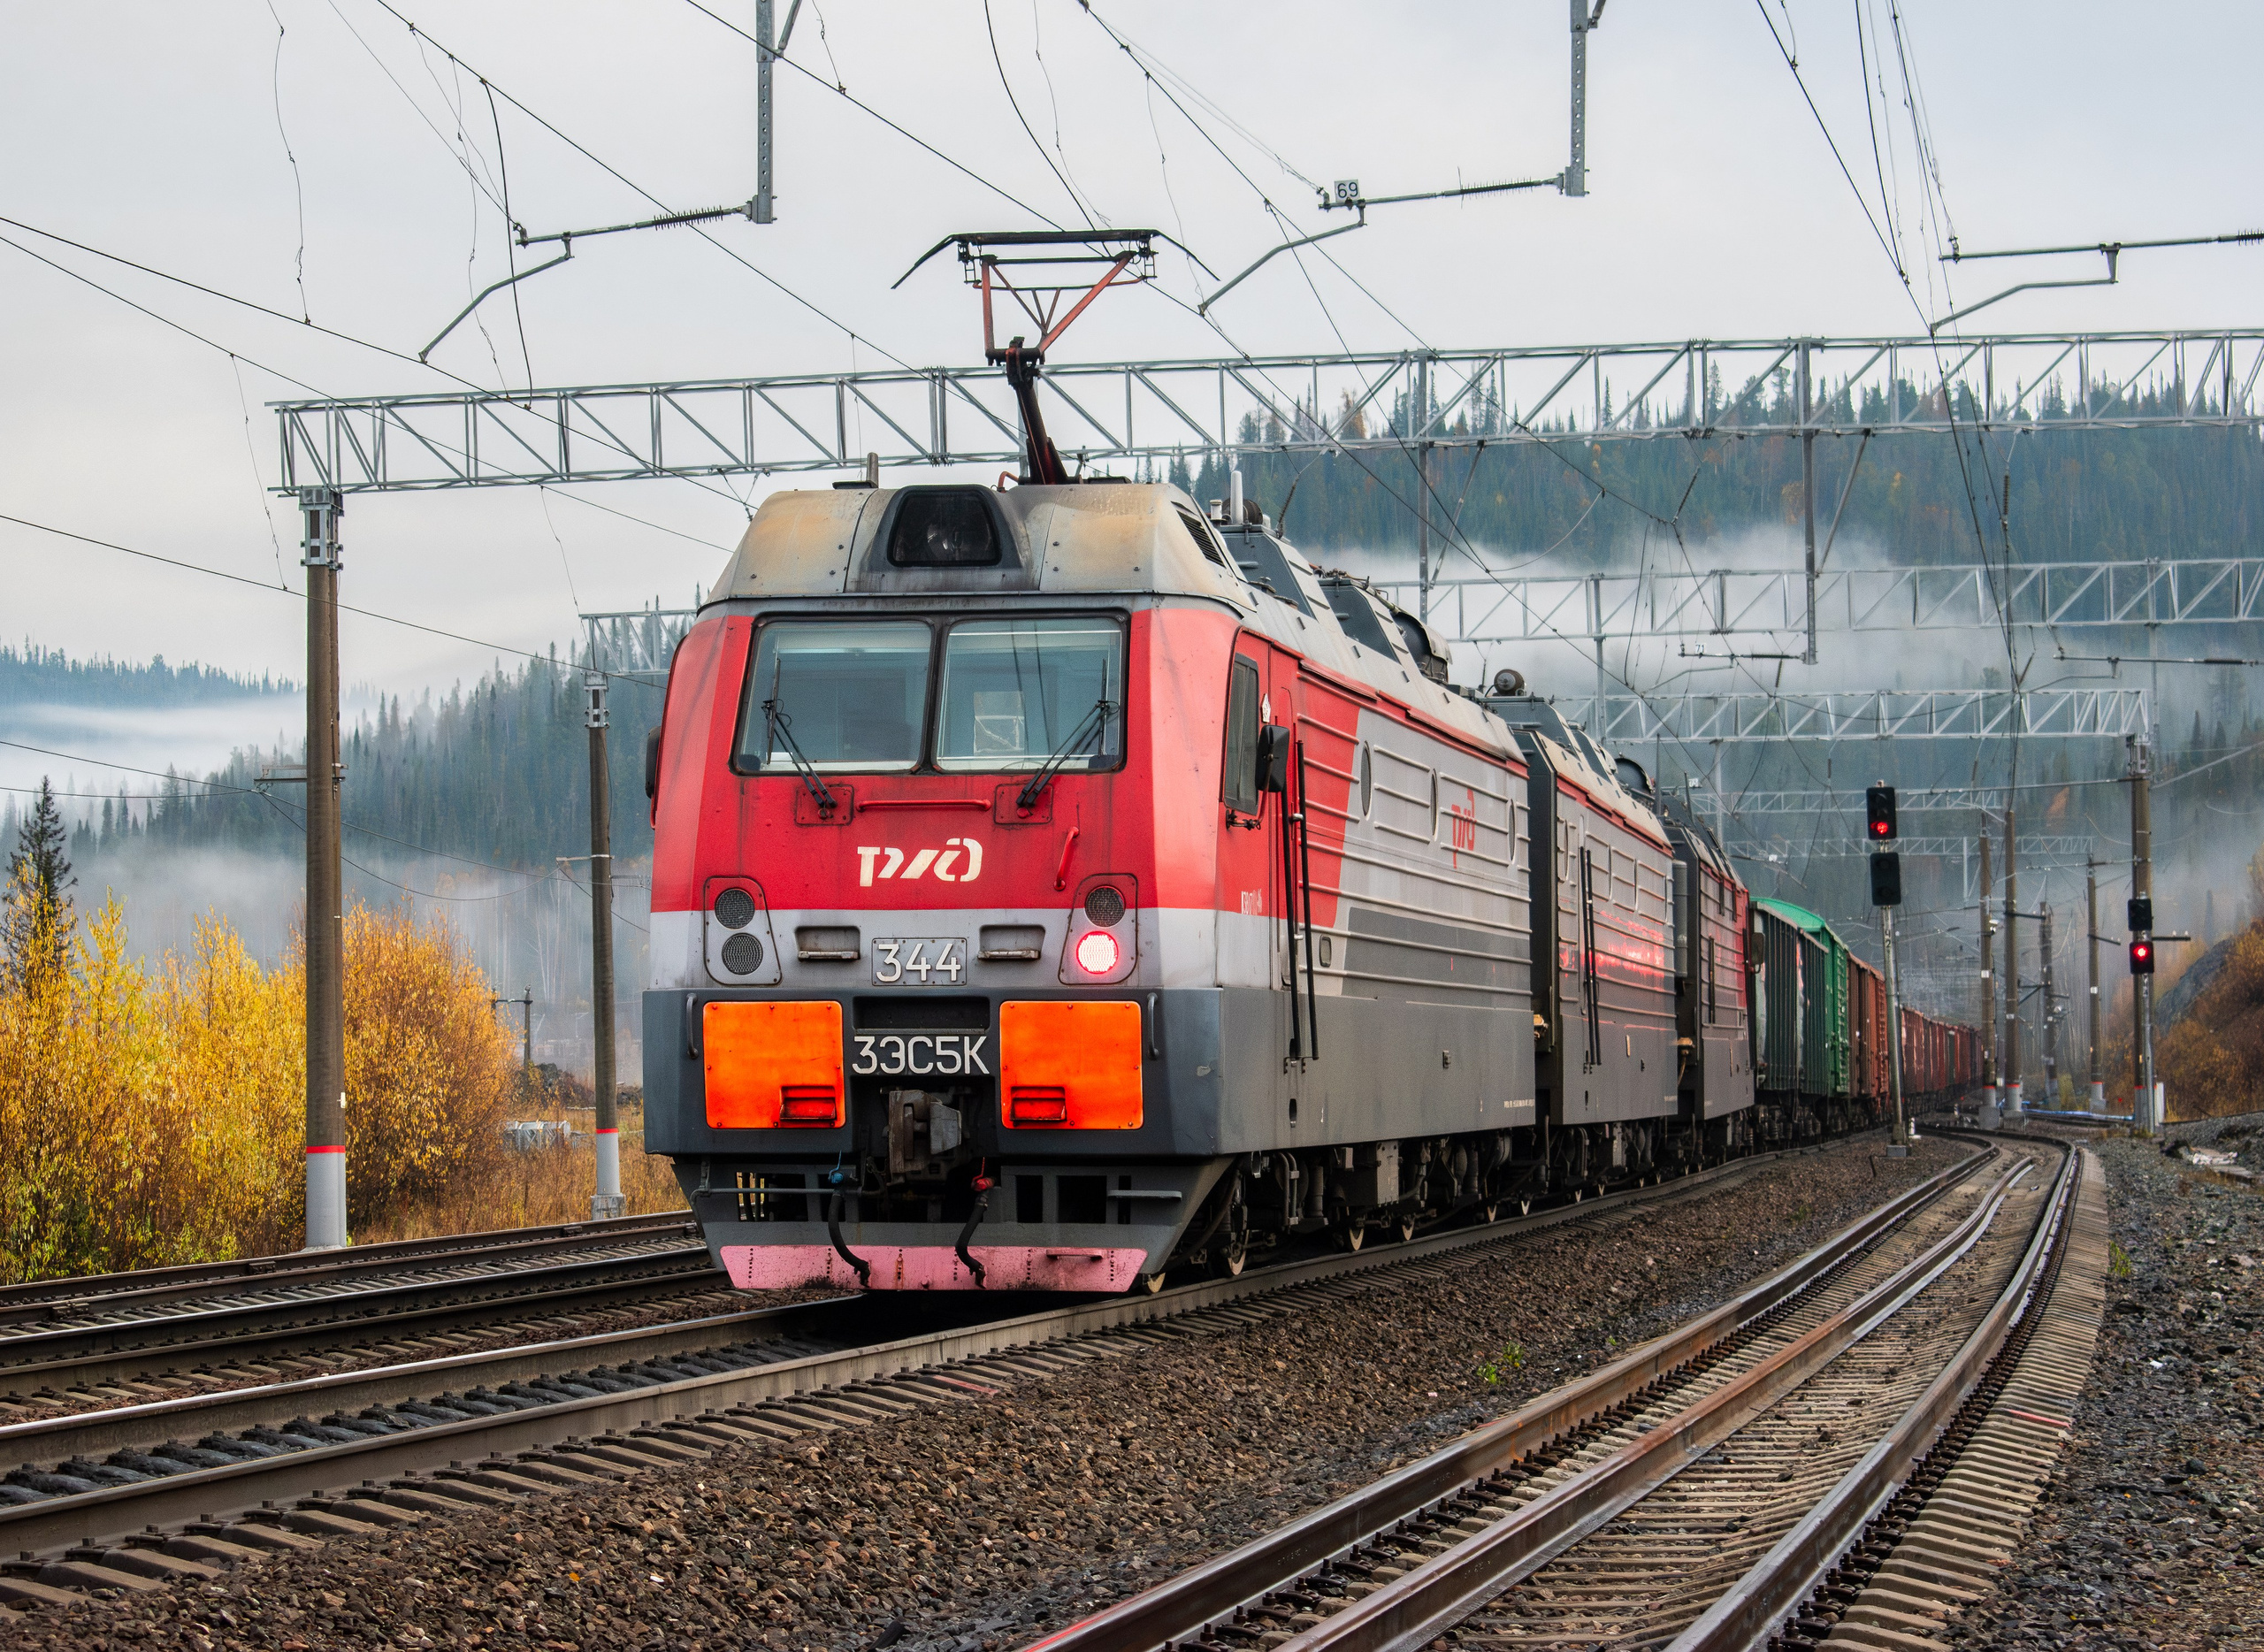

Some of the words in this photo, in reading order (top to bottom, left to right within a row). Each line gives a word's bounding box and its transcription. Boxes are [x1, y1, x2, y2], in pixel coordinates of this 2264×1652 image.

[1337, 181, 1358, 198] 69
[1695, 644, 1705, 654] 71
[857, 837, 983, 887] РЖД
[876, 943, 961, 983] 344
[852, 1036, 990, 1075] 3ЭС5К
